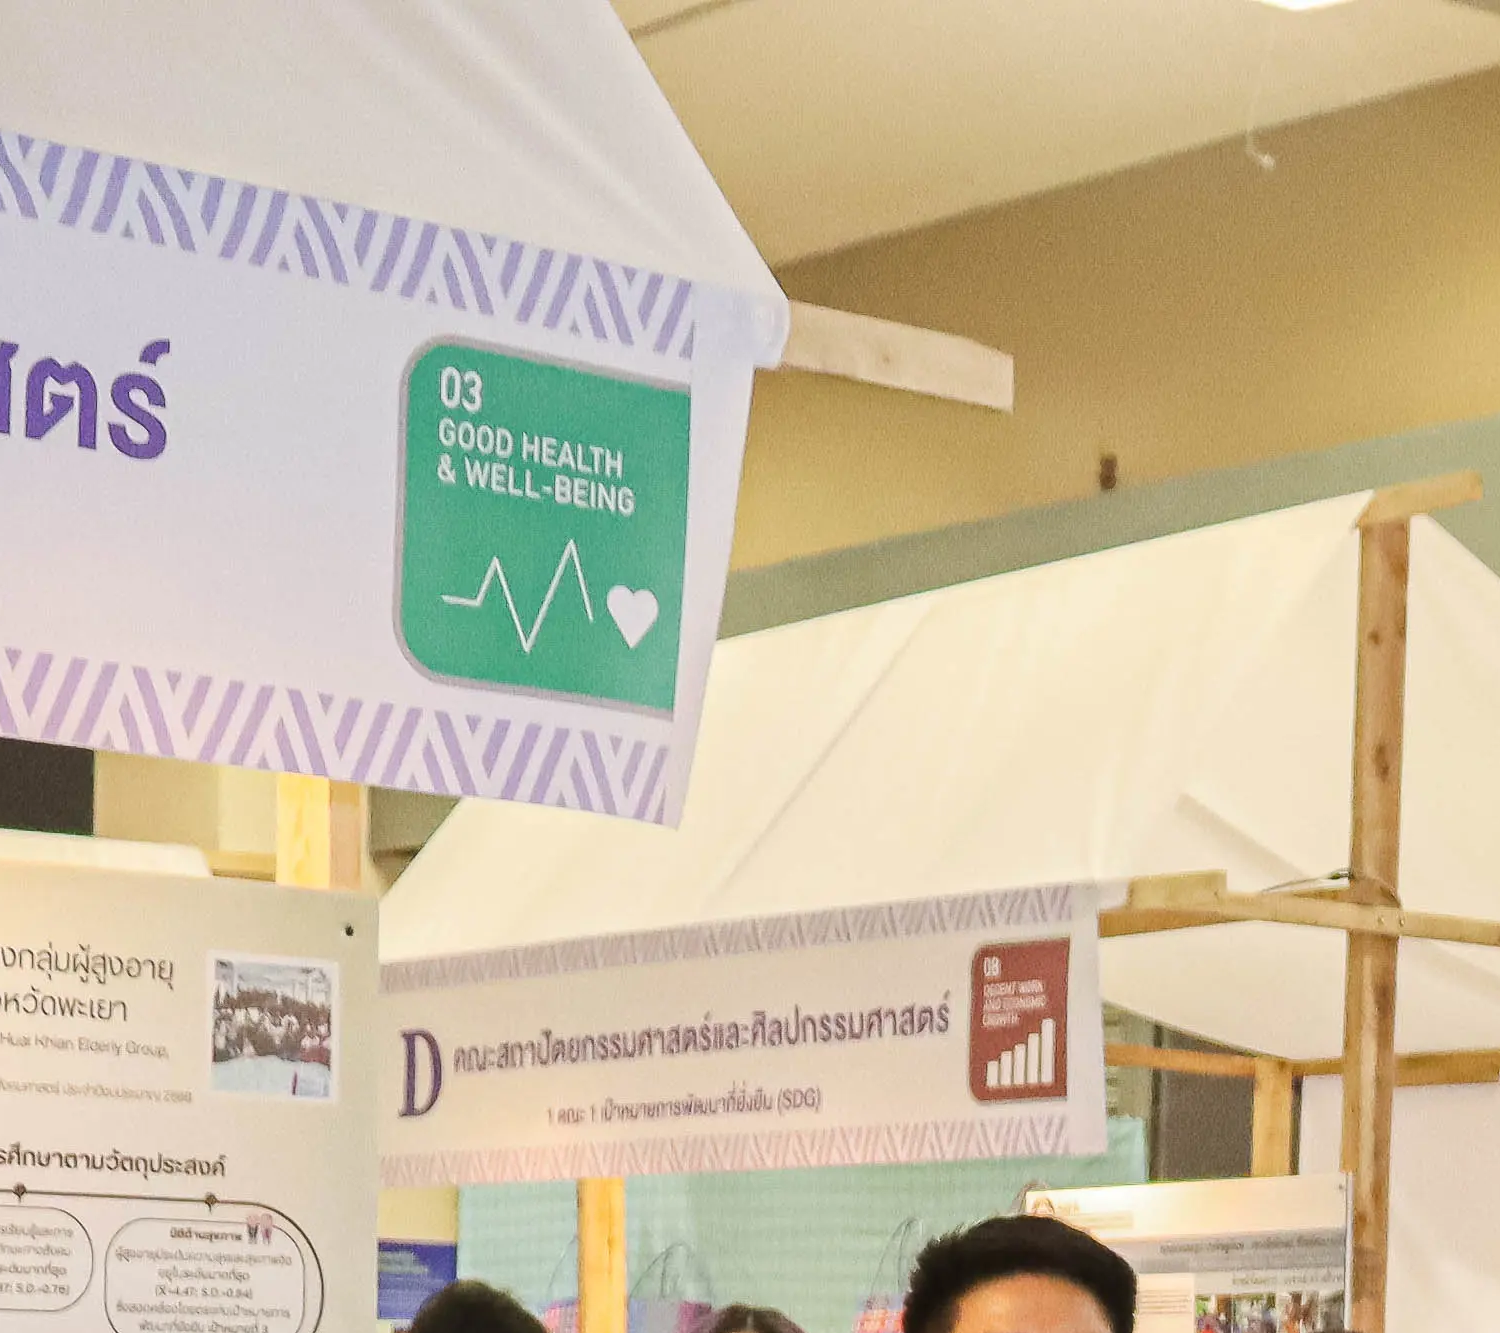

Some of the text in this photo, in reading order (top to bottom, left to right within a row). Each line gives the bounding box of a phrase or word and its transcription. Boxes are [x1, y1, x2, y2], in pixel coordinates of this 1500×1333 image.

[439, 365, 483, 412] 03
[438, 417, 624, 480] GOOD HEALTH
[437, 452, 636, 518] & WELL-BEING
[452, 990, 952, 1075] คณะสถาปัตยกรรมศาสตร์และศิลปกรรมศาสตร์
[398, 1028, 443, 1119] D
[777, 1087, 823, 1114] (SDG)
